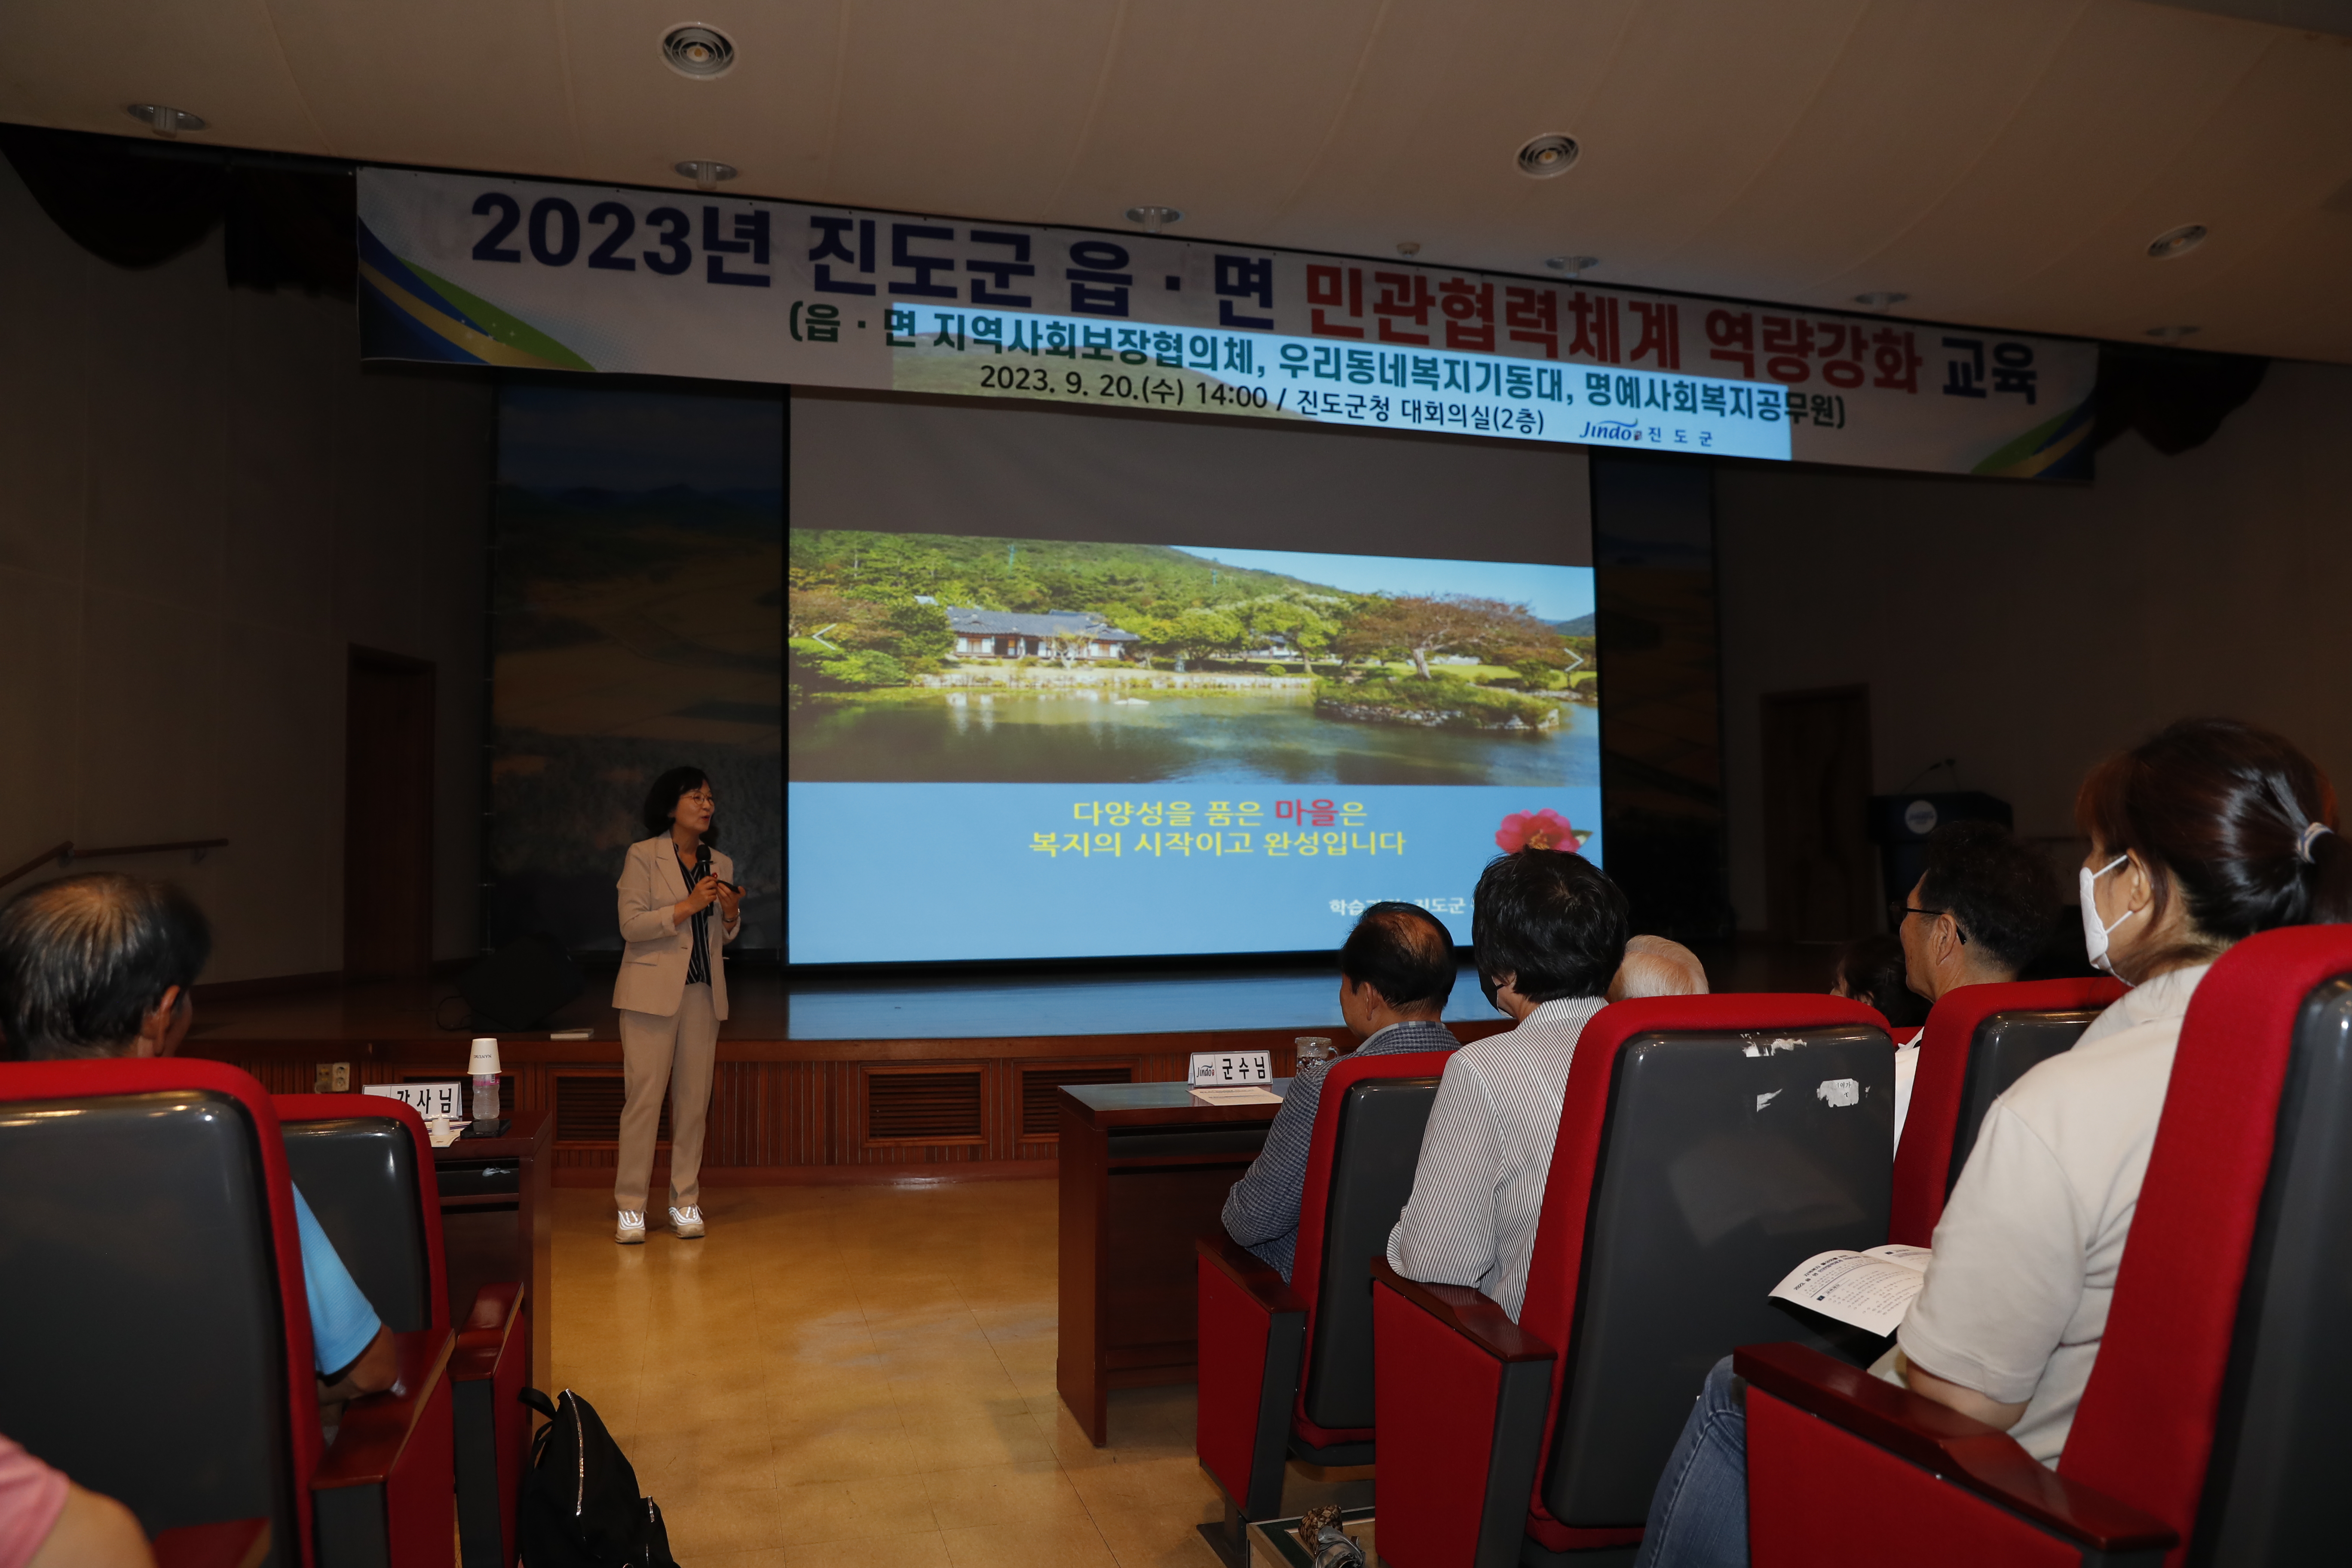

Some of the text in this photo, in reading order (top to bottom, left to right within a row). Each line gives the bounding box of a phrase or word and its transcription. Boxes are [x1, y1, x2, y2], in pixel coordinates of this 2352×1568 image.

[472, 192, 771, 287] 2023년
[808, 215, 1035, 308] 진도군
[1066, 241, 1133, 317] 읍
[1214, 254, 1274, 330] 면
[1306, 263, 1681, 370] 민관협력체계
[1705, 307, 1923, 395] 역량강화
[1941, 336, 2038, 405] 교육
[884, 309, 916, 348] 면
[933, 312, 1266, 378] 지역사회보장협의체,
[1279, 342, 1574, 404] 우리동네복지기동대,
[1585, 371, 1845, 429] 명예사회복지공무원)
[980, 364, 1056, 395] 2023.
[1066, 371, 1088, 397] 9.
[1099, 374, 1184, 406] 20.(수)
[1196, 381, 1268, 410] 14:00
[1297, 389, 1390, 422] 진도군청
[1401, 399, 1544, 436] 대회의실(2층)
[1579, 420, 1632, 441] Jindo
[1073, 798, 1367, 827] 다양성을 품은 마을은
[1029, 831, 1406, 858] 복지의 시작이고 완성입니다
